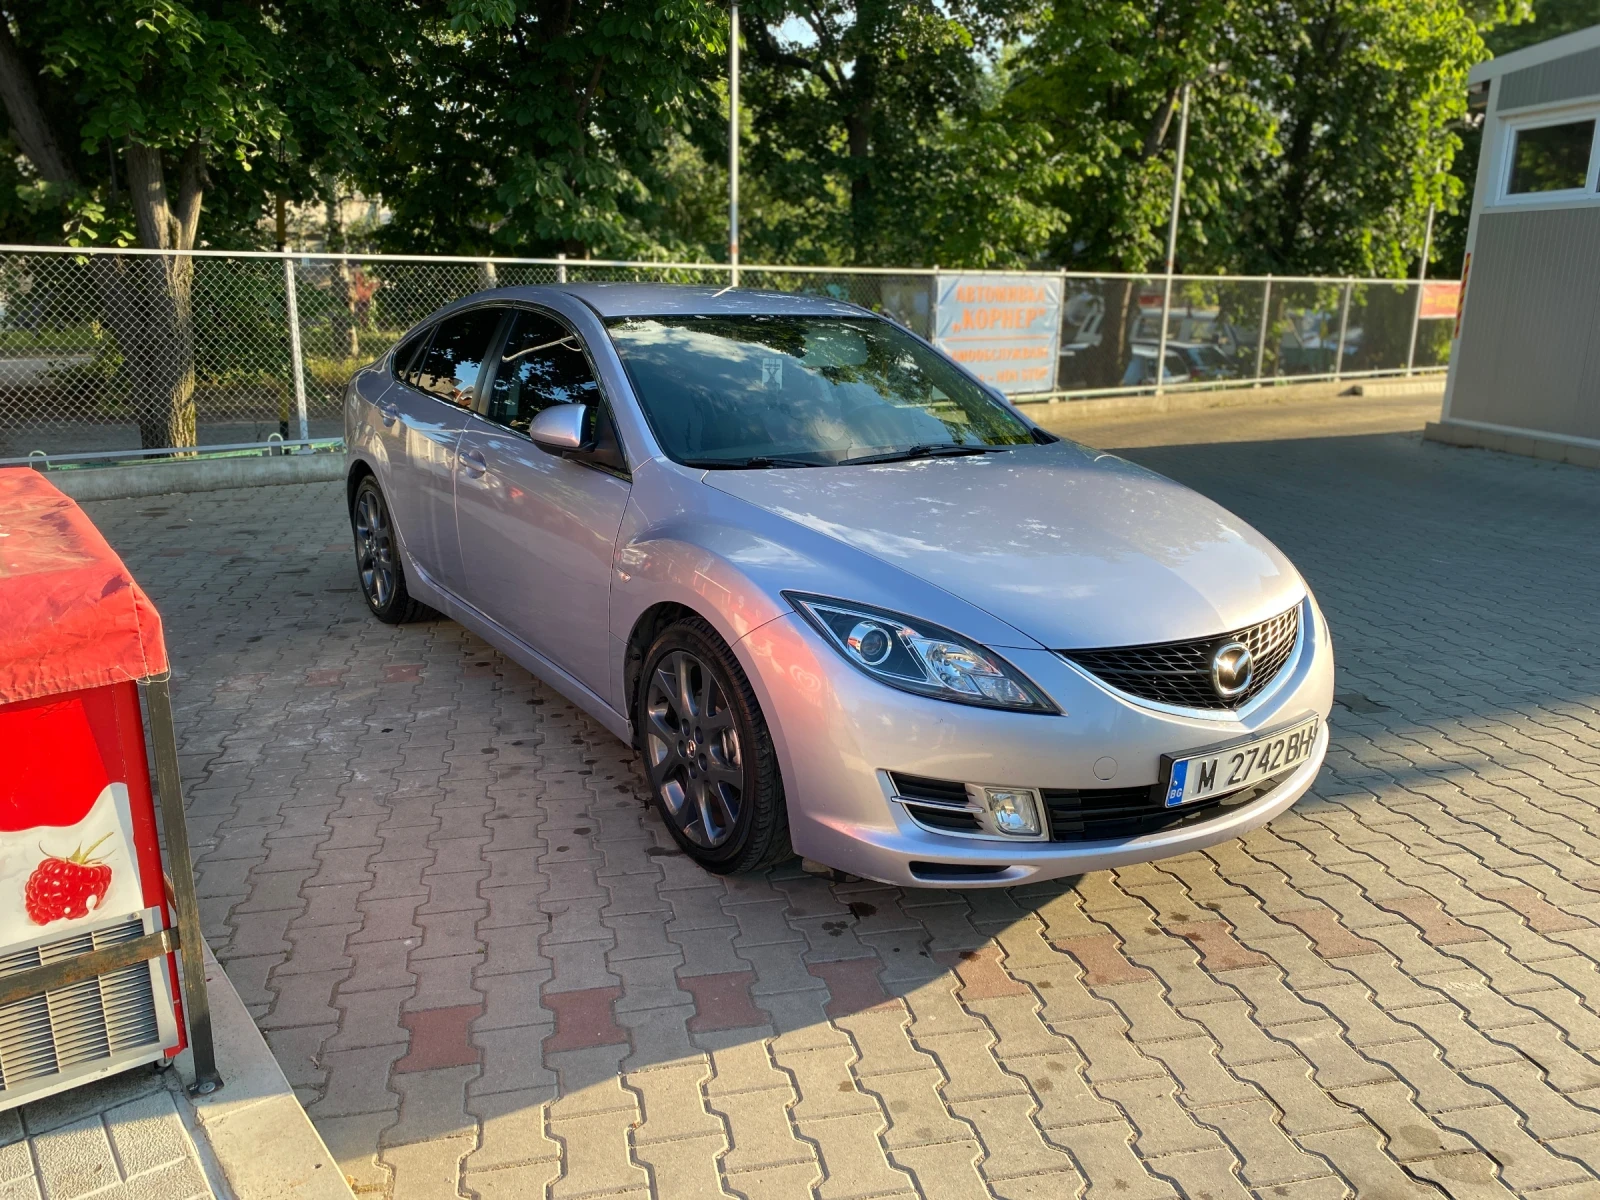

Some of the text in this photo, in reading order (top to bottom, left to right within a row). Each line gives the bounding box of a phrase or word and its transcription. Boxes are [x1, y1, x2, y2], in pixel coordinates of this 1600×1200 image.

[957, 286, 1045, 303] АВТОМИВКА
[1197, 759, 1217, 793] M
[1169, 788, 1183, 799] BG
